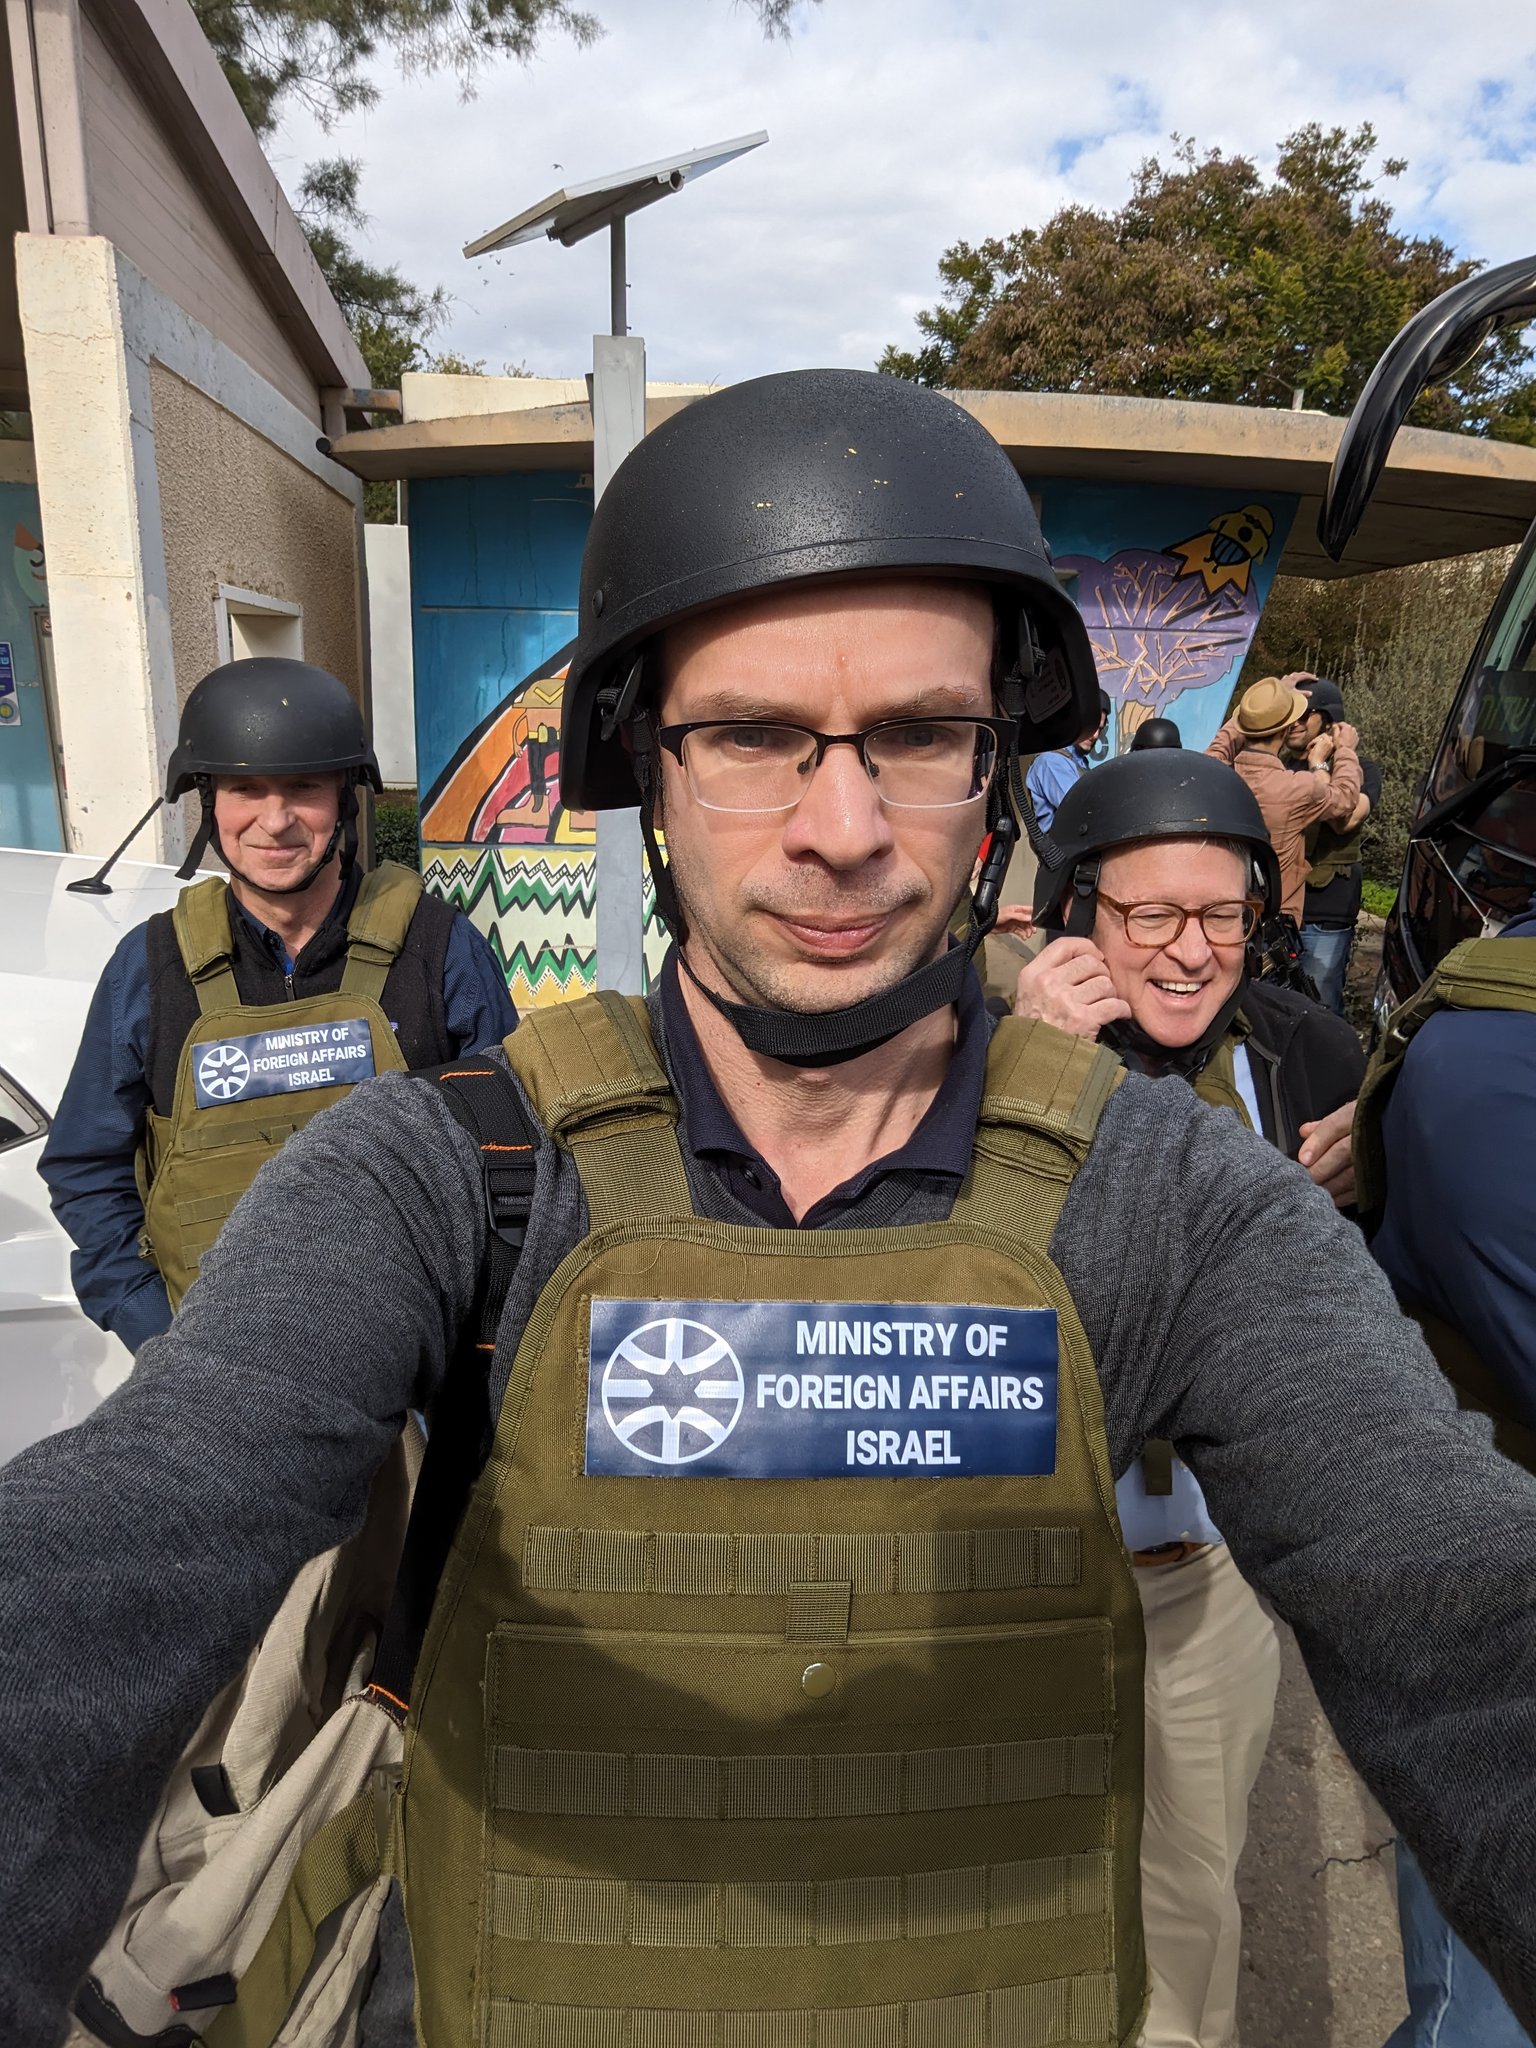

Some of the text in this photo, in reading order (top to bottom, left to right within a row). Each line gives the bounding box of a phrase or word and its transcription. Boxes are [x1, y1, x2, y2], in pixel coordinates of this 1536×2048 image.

[266, 1028, 349, 1050] MINISTRY OF
[254, 1045, 366, 1072] FOREIGN AFFAIRS
[289, 1069, 335, 1086] ISRAEL
[796, 1320, 1008, 1357] MINISTRY OF
[756, 1374, 1044, 1410] FOREIGN AFFAIRS
[846, 1430, 961, 1466] ISRAEL
